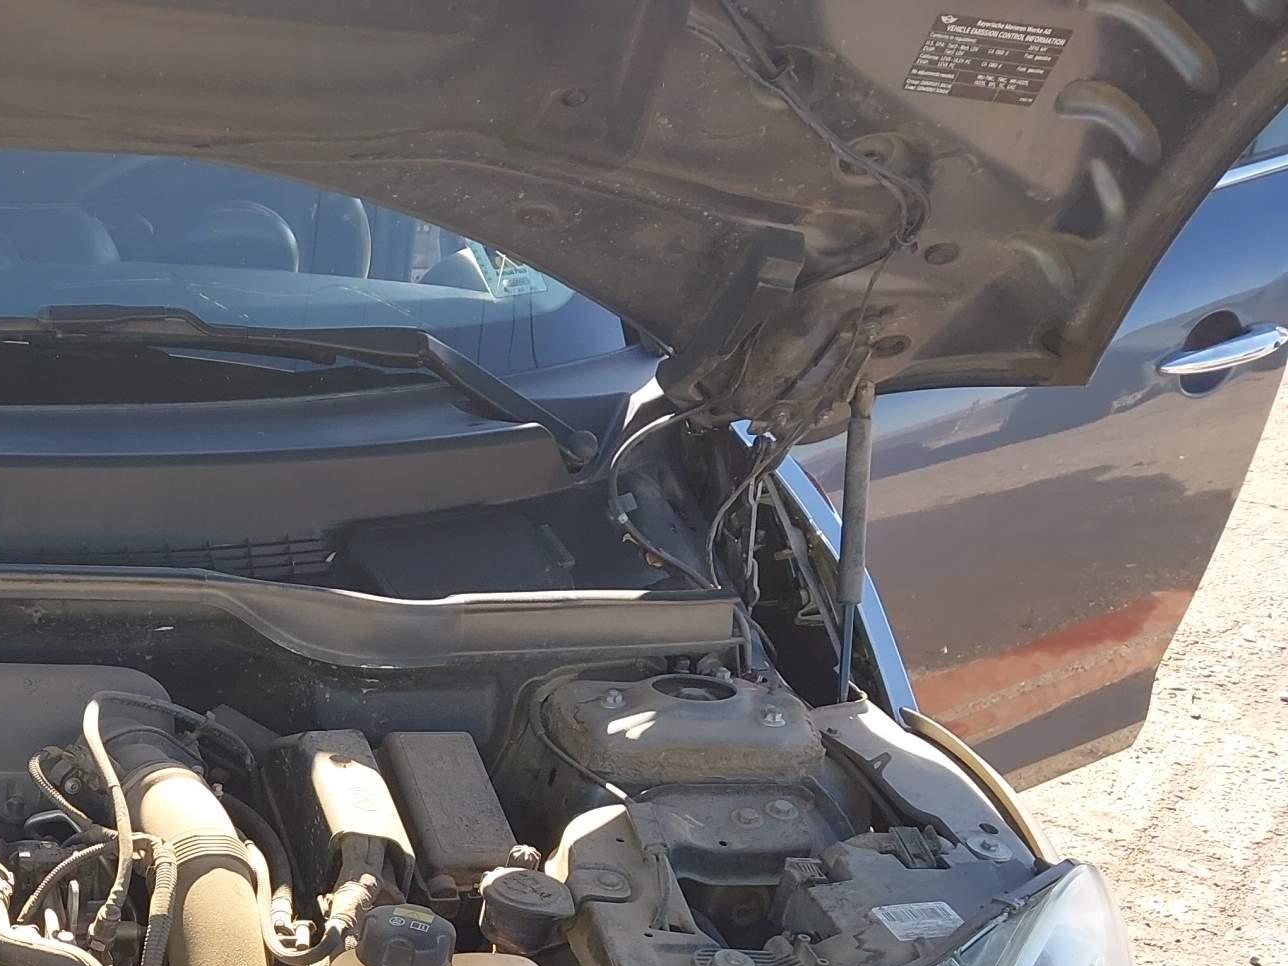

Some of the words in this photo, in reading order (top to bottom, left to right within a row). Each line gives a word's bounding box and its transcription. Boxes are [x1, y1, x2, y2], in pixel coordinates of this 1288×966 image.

[946, 24, 972, 34] VEHICLE
[970, 27, 1000, 38] EMISSION
[998, 30, 1026, 41] CONTROL
[1024, 34, 1067, 46] INFORMATION
